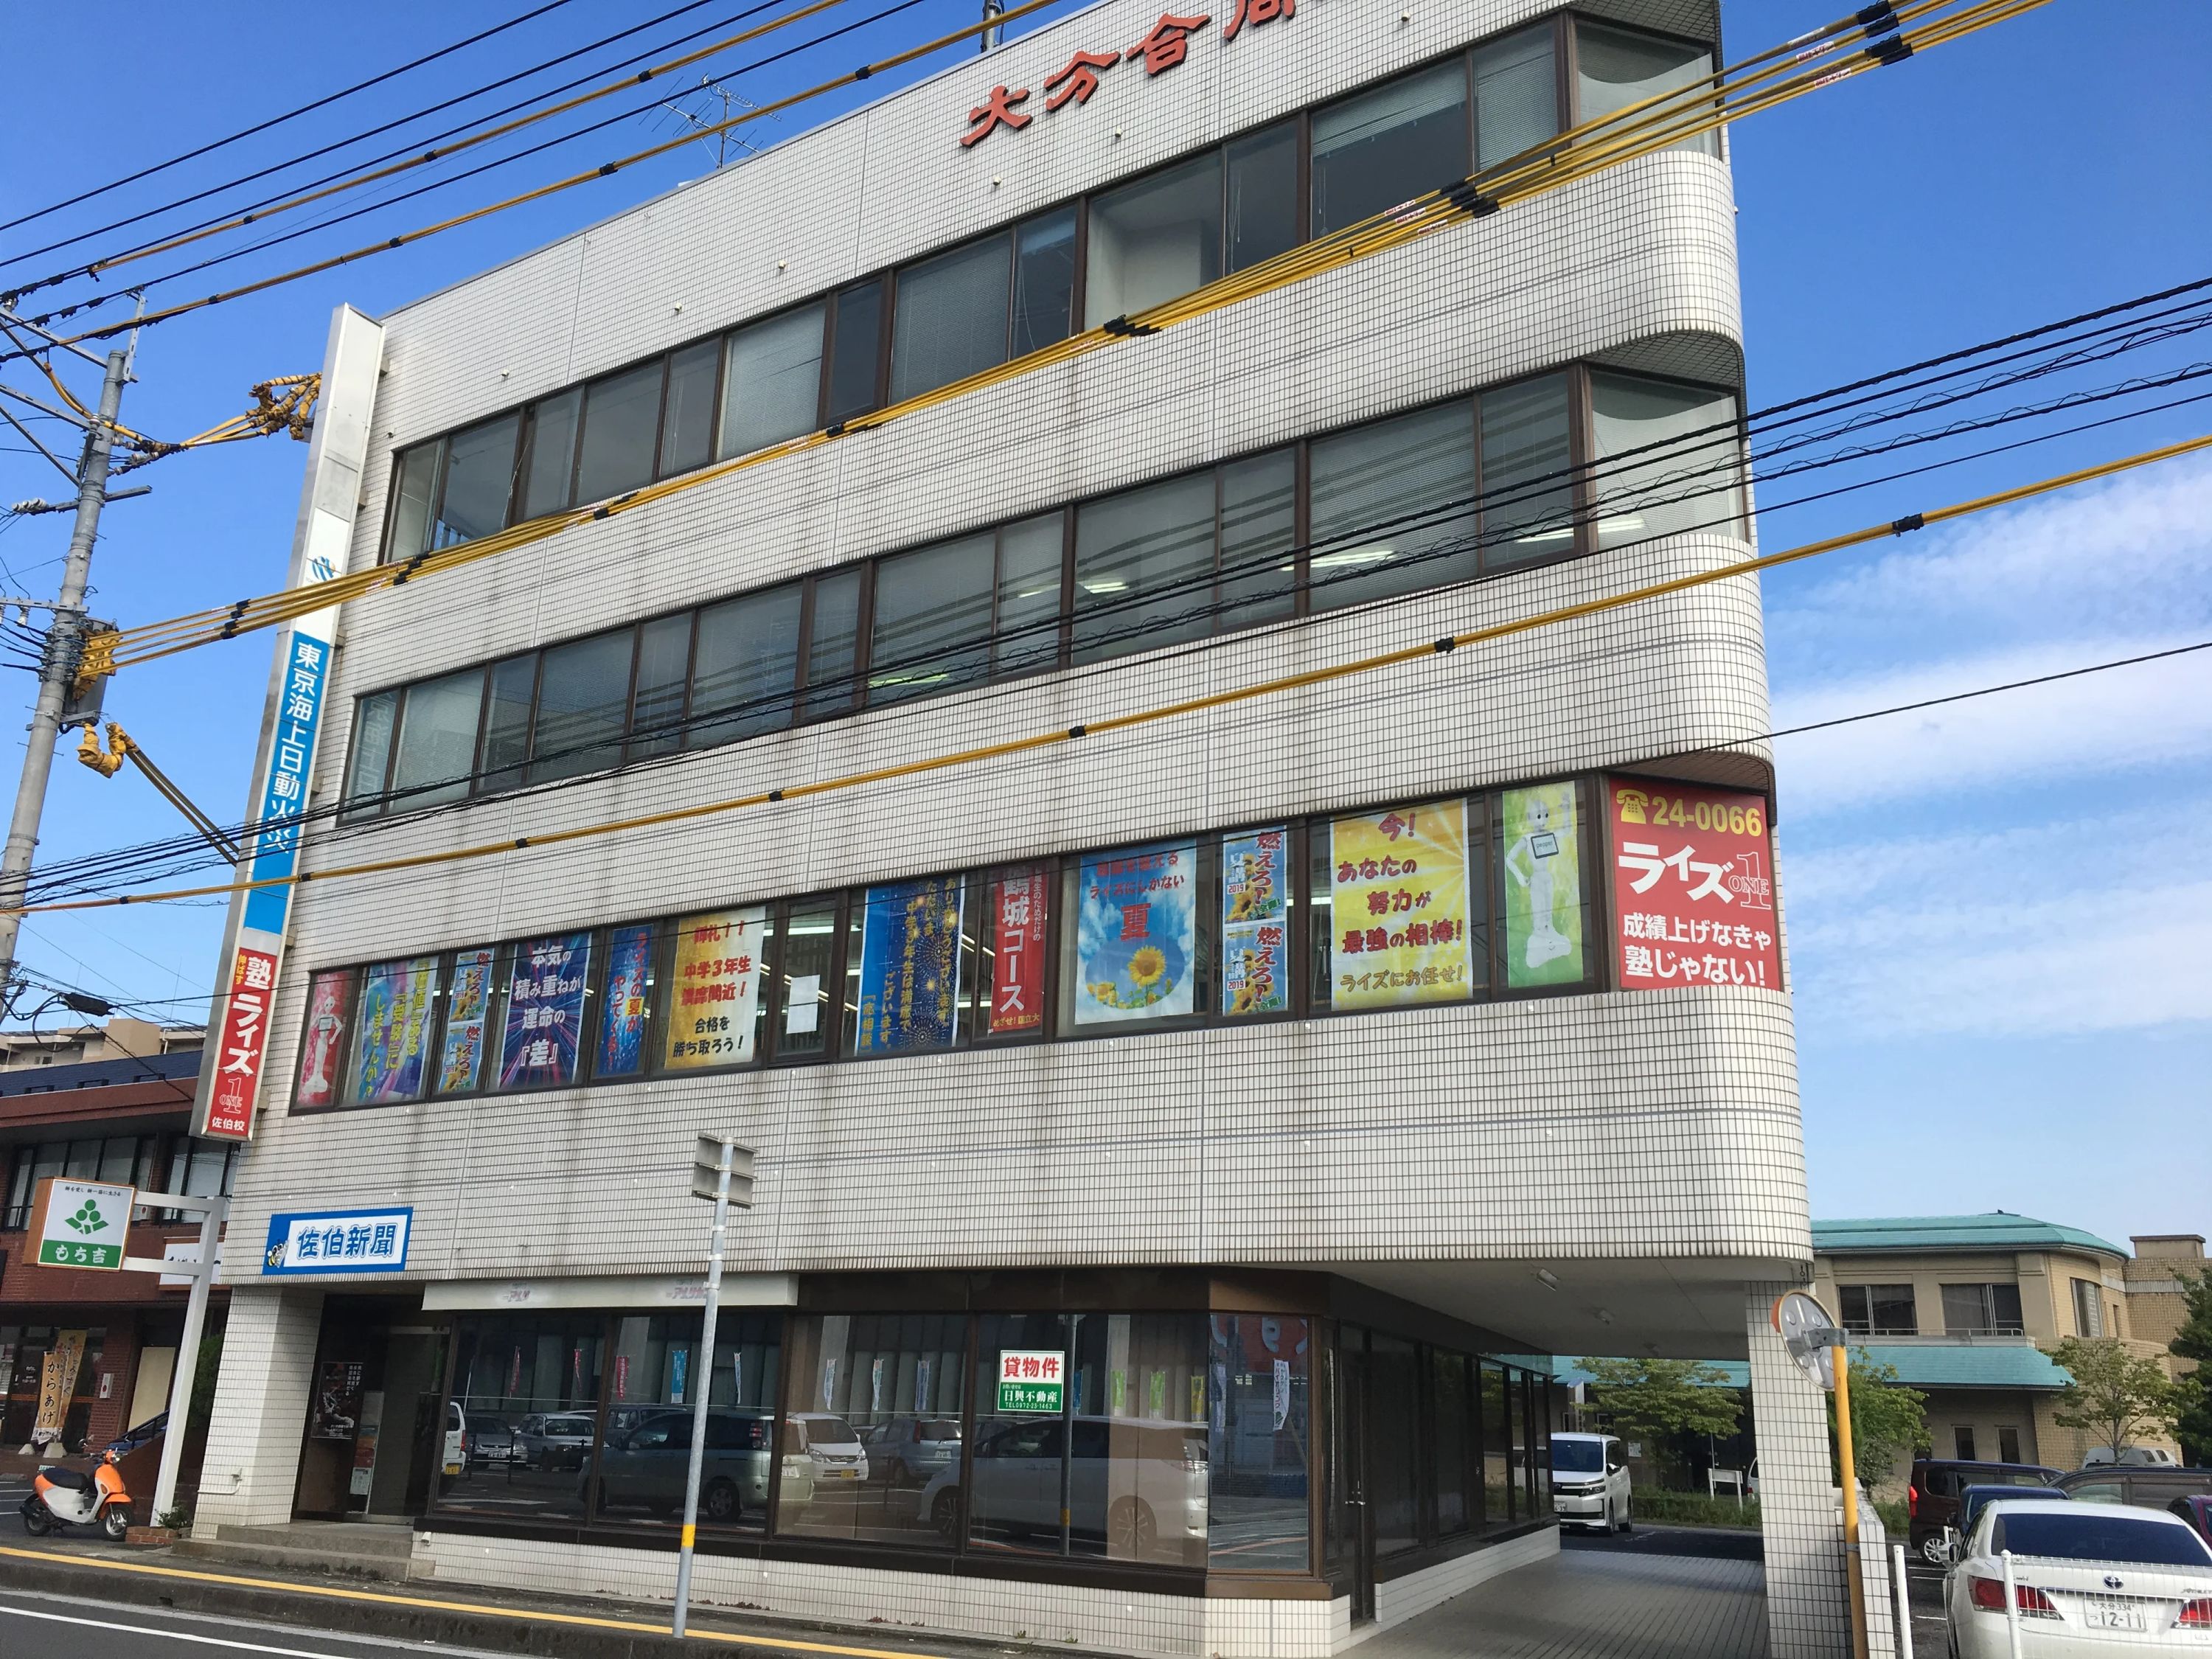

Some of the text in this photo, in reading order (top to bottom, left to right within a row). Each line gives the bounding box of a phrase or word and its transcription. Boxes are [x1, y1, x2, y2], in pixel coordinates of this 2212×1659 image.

[1652, 796, 1762, 837] 24-0066
[1338, 855, 1417, 883] あなたの
[1618, 841, 1735, 904] ライズ
[1091, 875, 1185, 899] ライズにしかない
[1228, 884, 1244, 893] 2019
[1728, 874, 1770, 896] ONE
[1367, 888, 1431, 916] 努力が
[1119, 902, 1151, 942] 夏
[1623, 912, 1771, 950] 成績上げなきゃ
[532, 946, 571, 967] 本気の
[235, 954, 246, 985] 伸ばす
[515, 975, 582, 1001] 積み重ねが
[1228, 981, 1244, 990] 2019
[522, 1006, 566, 1030] 運命の
[695, 1016, 730, 1034] 合格を
[220, 1093, 243, 1107] ONE
[212, 1116, 246, 1132] 佐伯校
[297, 1222, 398, 1259] 佐伯新聞
[55, 1245, 106, 1264] もち吉
[1004, 1356, 1060, 1378] 貸物件
[43, 1360, 59, 1424] からあげ
[1005, 1390, 1057, 1402] 日興不動産
